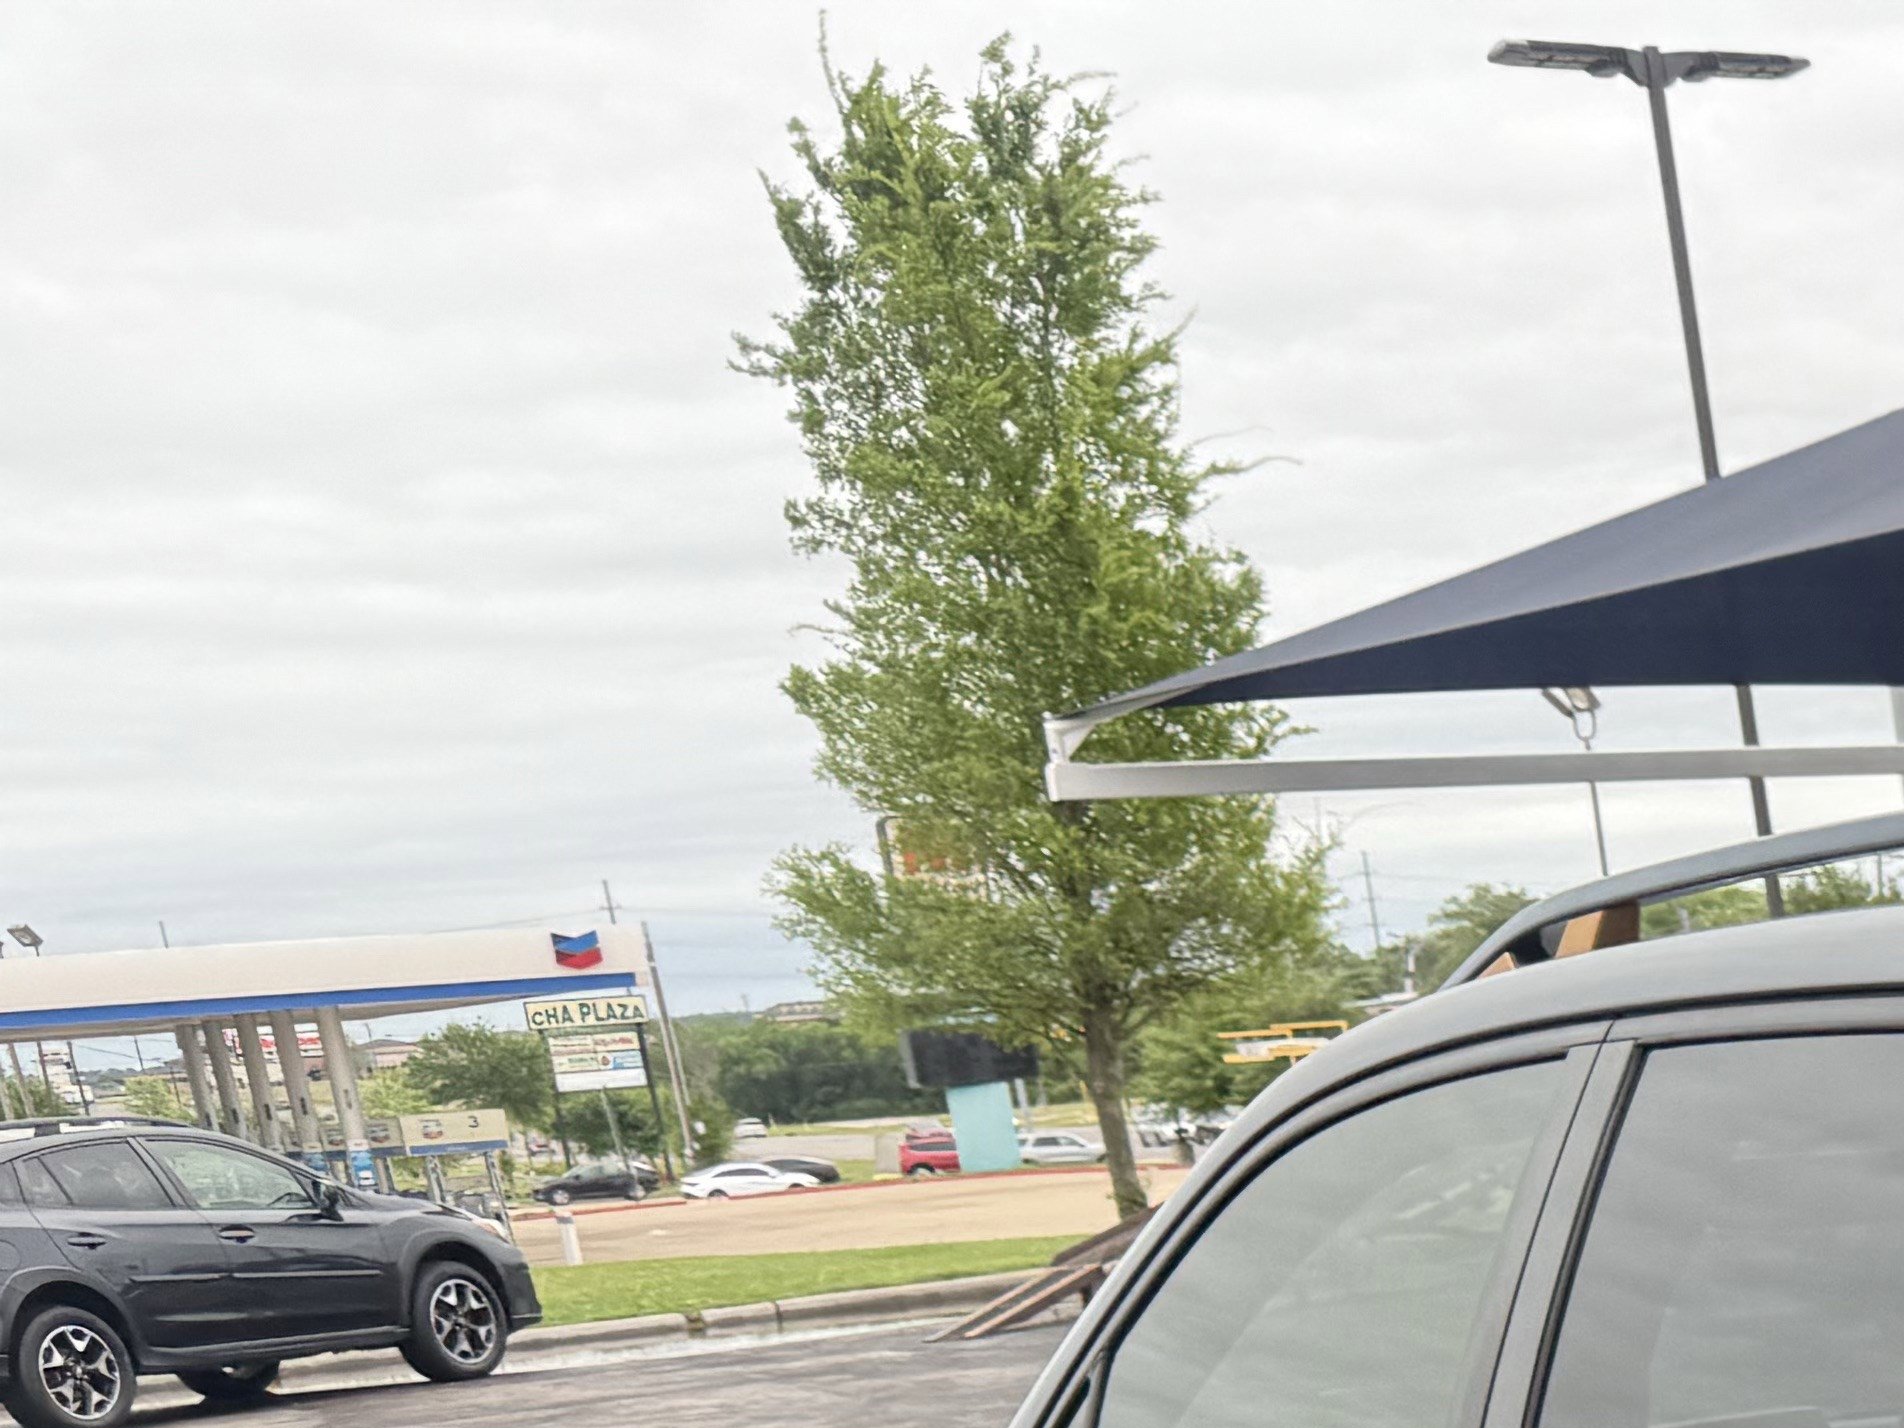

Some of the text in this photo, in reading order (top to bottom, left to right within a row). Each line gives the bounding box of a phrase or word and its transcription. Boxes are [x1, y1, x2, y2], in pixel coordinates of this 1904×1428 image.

[532, 1002, 644, 1026] CHA PLAZA
[467, 1115, 480, 1128] 3
